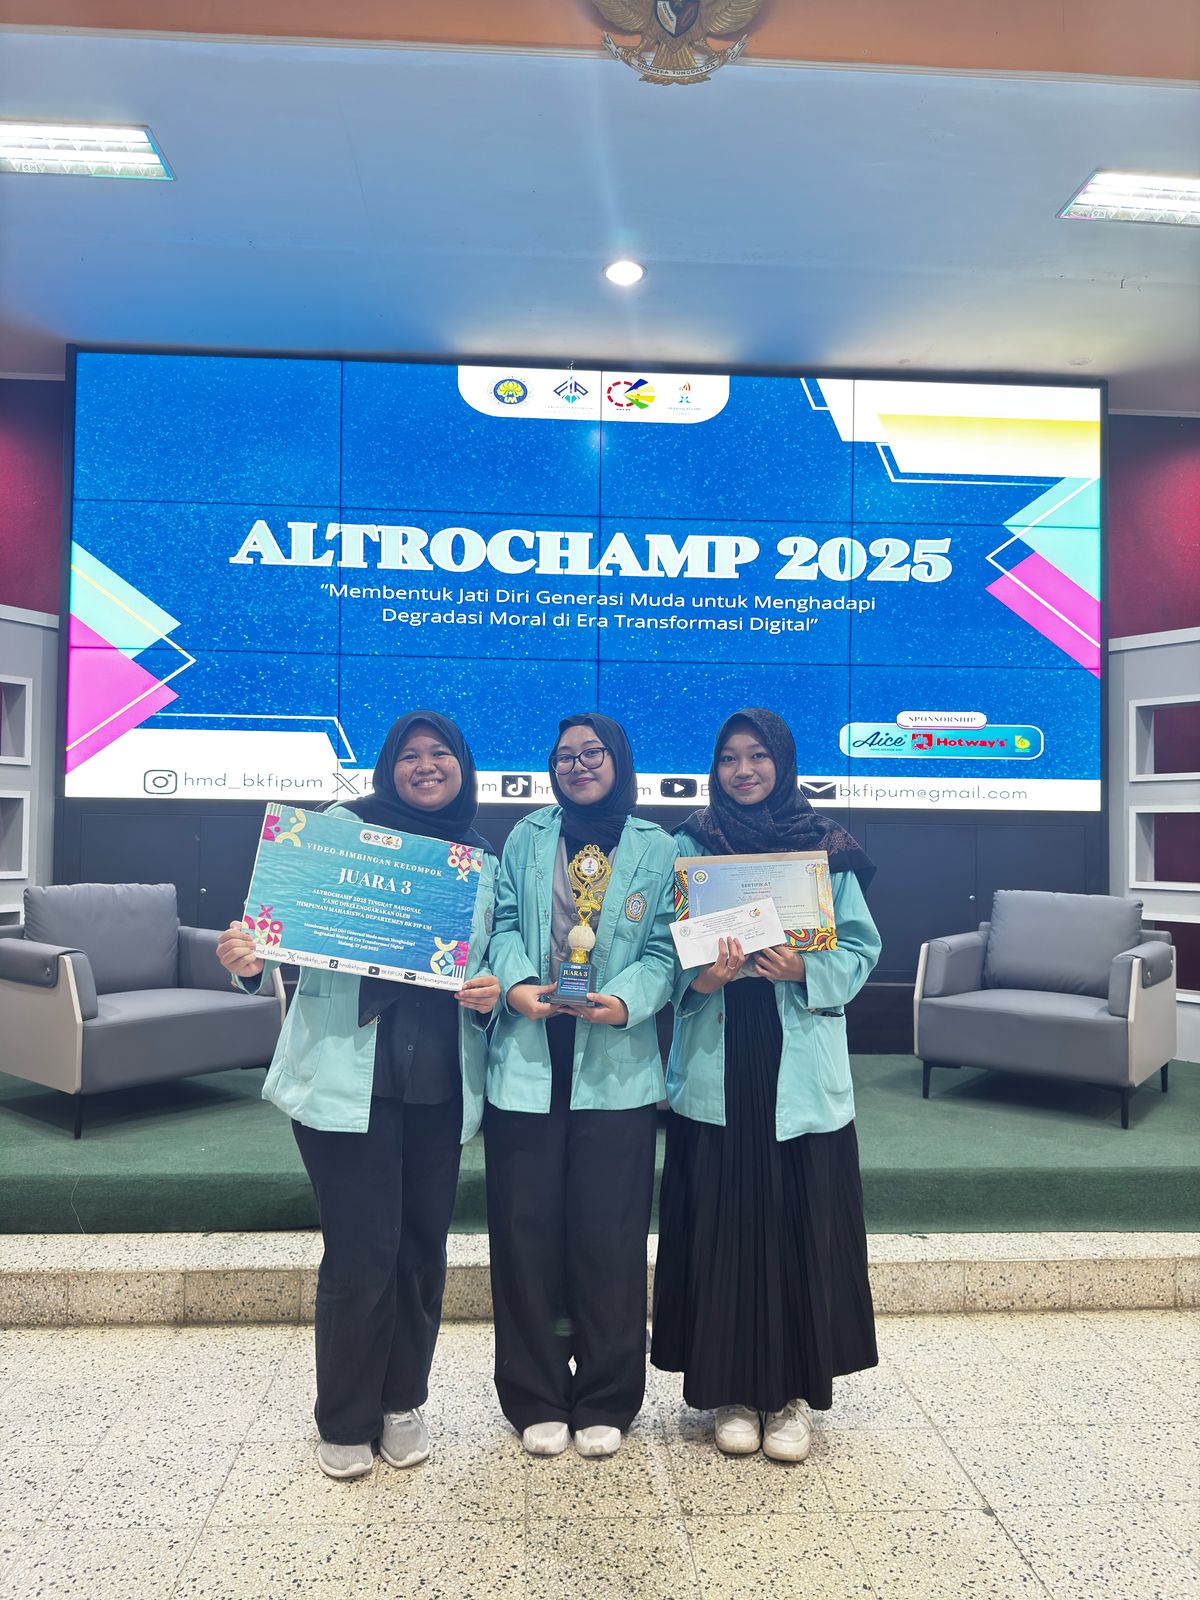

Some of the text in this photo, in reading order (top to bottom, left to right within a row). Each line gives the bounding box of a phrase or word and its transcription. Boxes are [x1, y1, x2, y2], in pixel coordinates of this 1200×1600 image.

[229, 519, 953, 583] ALTROCHAMP 2025
[456, 587, 490, 603] Jati
[496, 588, 531, 604] Diri
[535, 590, 624, 606] Generasi
[629, 591, 686, 607] Muda
[691, 594, 748, 609] untuk
[754, 594, 877, 613] Menghadapi
[381, 608, 484, 628] Degradasi
[489, 611, 547, 627] Moral
[552, 611, 571, 627] di
[576, 613, 609, 629] Era
[613, 614, 744, 631] Transformasi
[908, 716, 977, 724] SPONSORSHIP
[852, 731, 906, 748] Aice
[183, 772, 323, 791] hmd_bkfipum
[839, 784, 1028, 803] bkfipum@gmail.com
[307, 842, 442, 877] VIDEO BIMBINGAN KELOMPOK
[337, 867, 412, 895] JUARA 3
[312, 889, 353, 901] ALTROCHAMP
[368, 899, 393, 909] TINGKAT
[323, 897, 339, 905] YANG
[296, 900, 329, 911] HIMPUNAN
[329, 907, 365, 919] MAHASISWA
[365, 913, 404, 926] DEPARTEMEN
